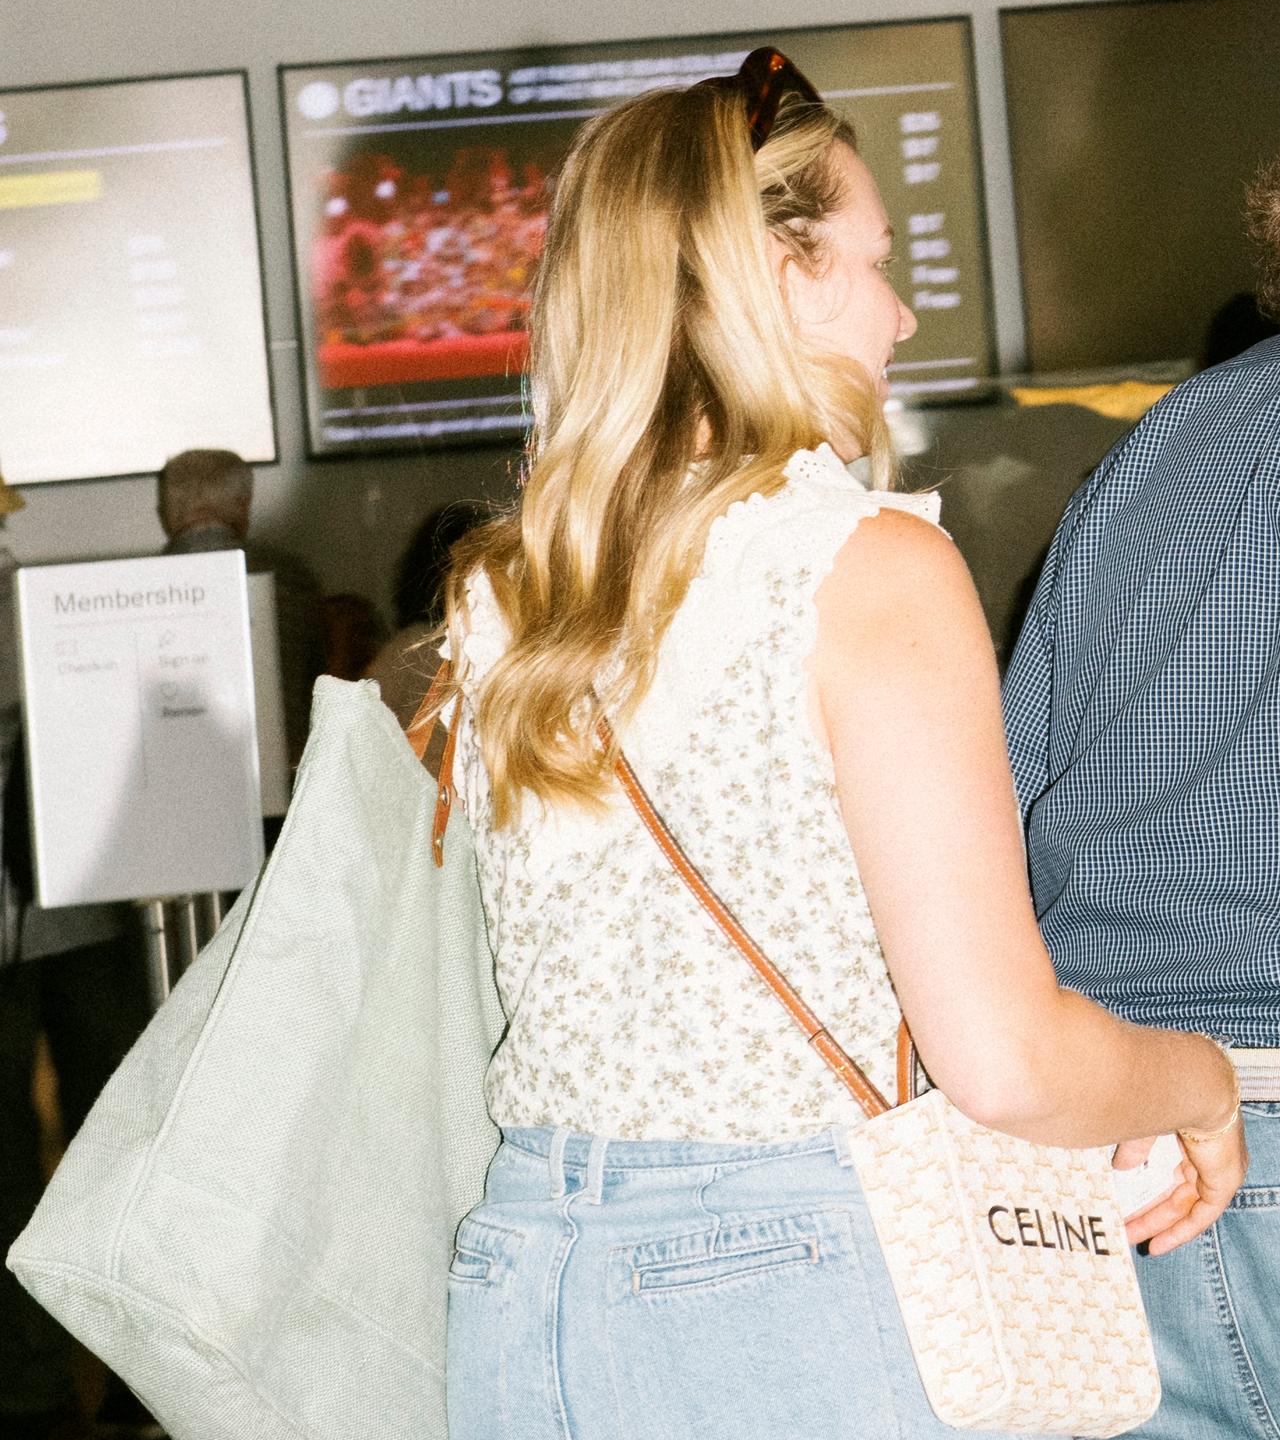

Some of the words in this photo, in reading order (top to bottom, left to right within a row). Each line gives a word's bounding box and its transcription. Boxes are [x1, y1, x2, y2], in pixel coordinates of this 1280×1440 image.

[344, 69, 502, 117] GIANTS
[53, 583, 206, 615] Membership
[987, 1205, 1110, 1256] CELINE
